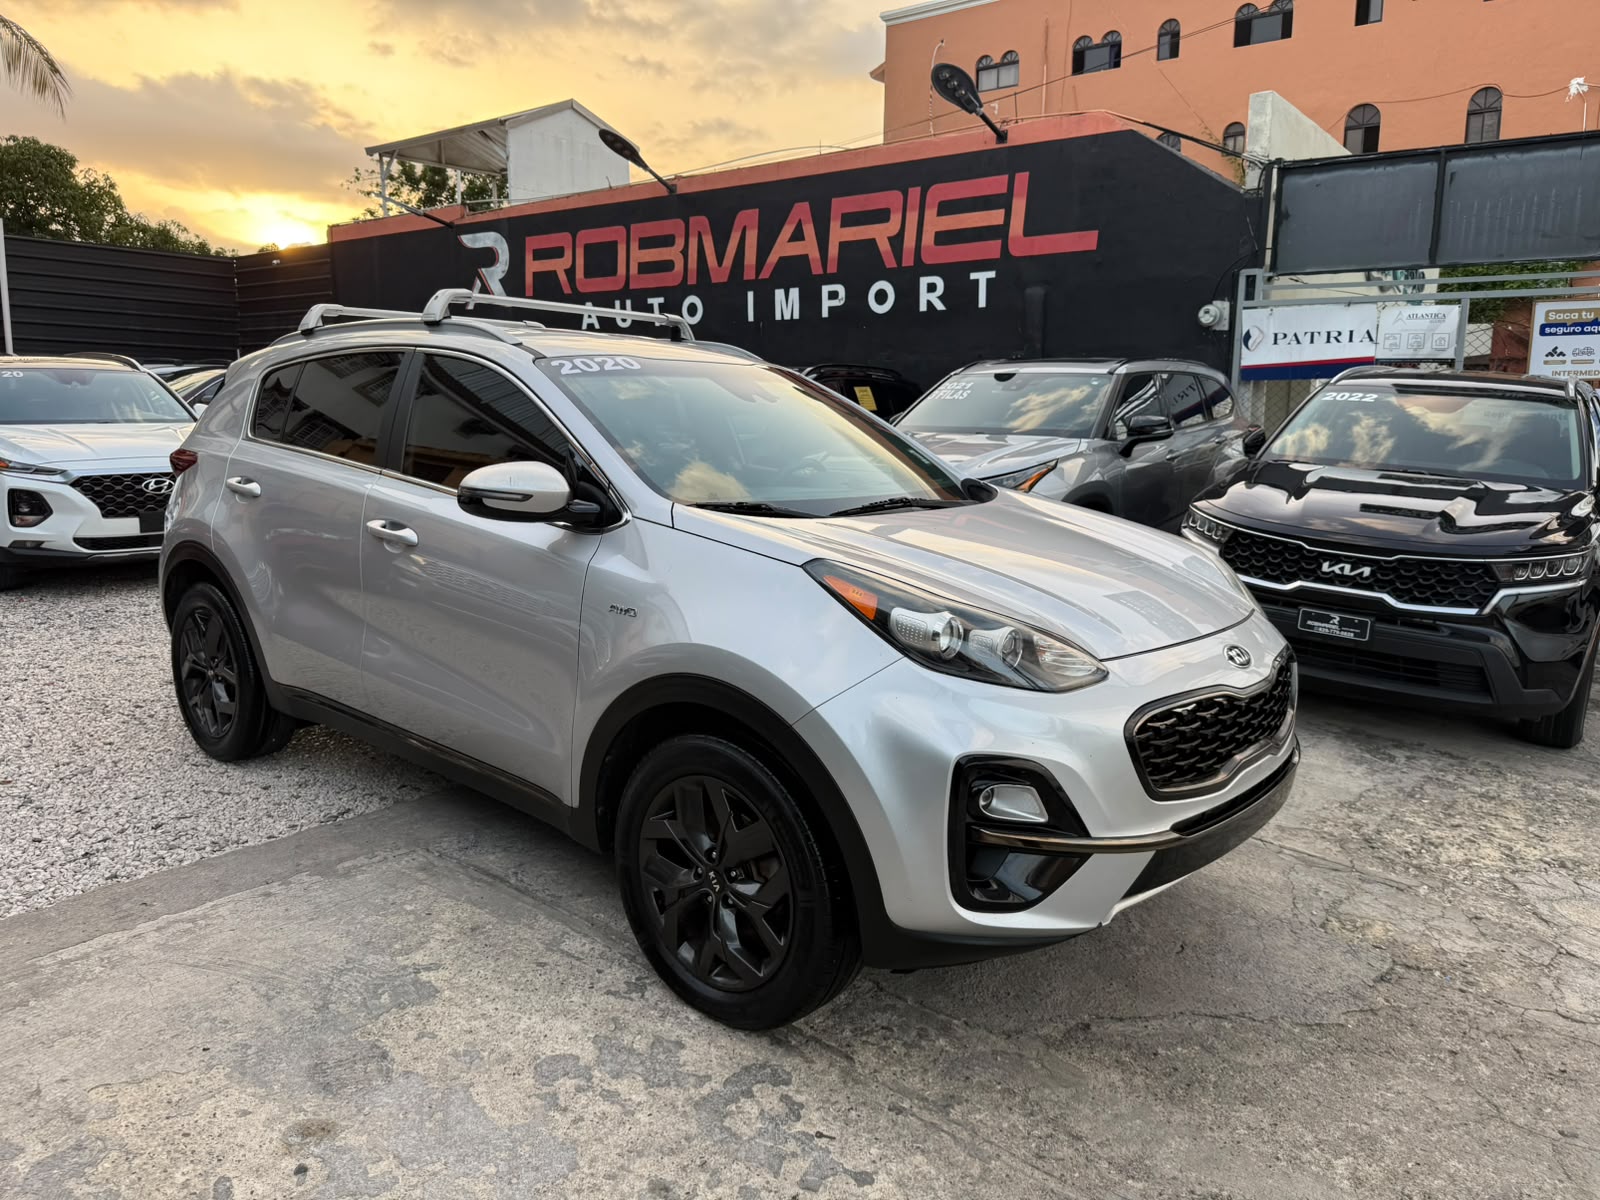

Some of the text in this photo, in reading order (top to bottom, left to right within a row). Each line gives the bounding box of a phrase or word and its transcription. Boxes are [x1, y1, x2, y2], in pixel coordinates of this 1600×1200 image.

[526, 172, 1099, 297] ROBMARIEL
[581, 270, 997, 330] AUTO IMPORT
[1406, 312, 1446, 320] ATLANTICA
[1548, 311, 1595, 320] Saca tu
[1272, 328, 1378, 346] PATRIA
[1544, 326, 1582, 334] seguro
[550, 356, 641, 375] 2020
[1321, 392, 1378, 402] 2022
[1321, 561, 1371, 577] KIA
[707, 870, 720, 893] KIA
